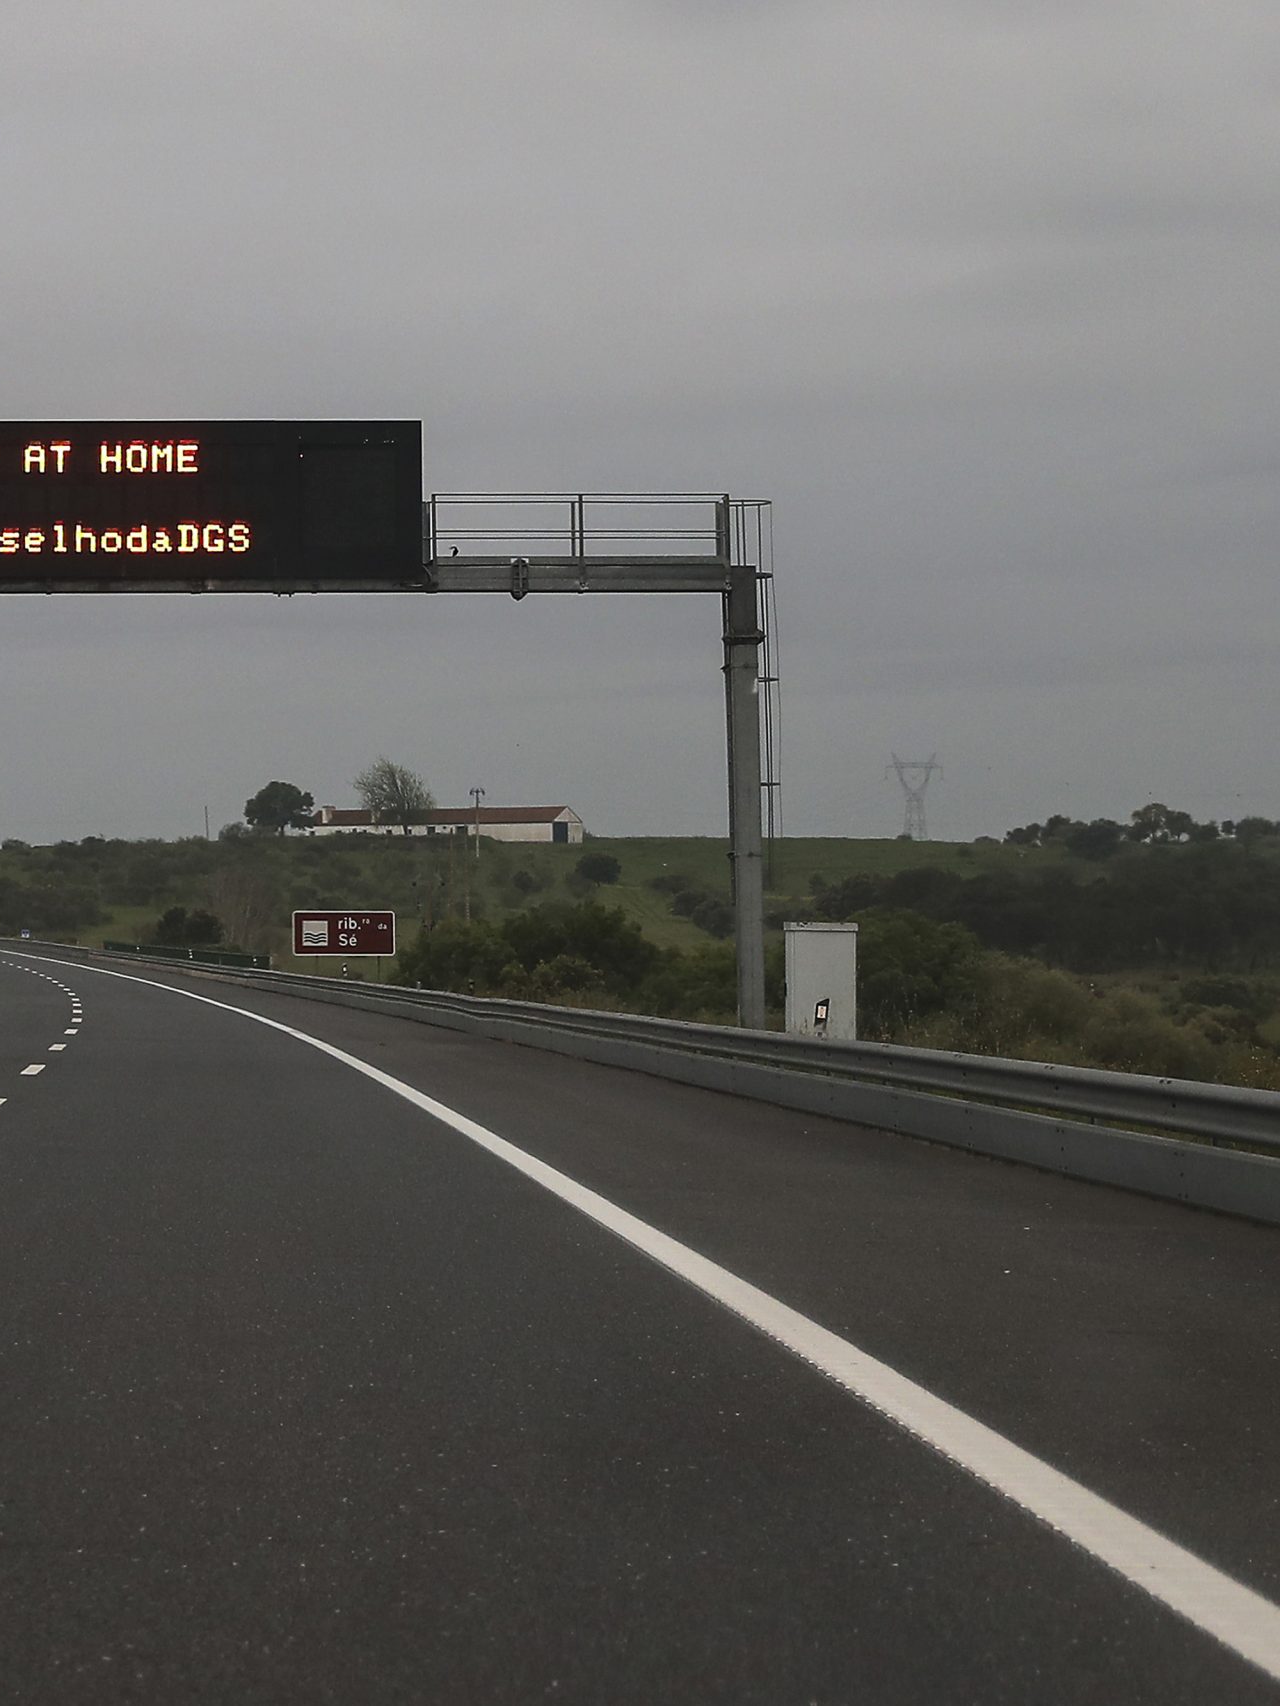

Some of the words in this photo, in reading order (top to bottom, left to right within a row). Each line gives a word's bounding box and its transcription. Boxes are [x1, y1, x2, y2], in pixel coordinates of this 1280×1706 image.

[24, 442, 71, 474] AT
[100, 442, 199, 474] HOME
[338, 933, 357, 946] Sé
